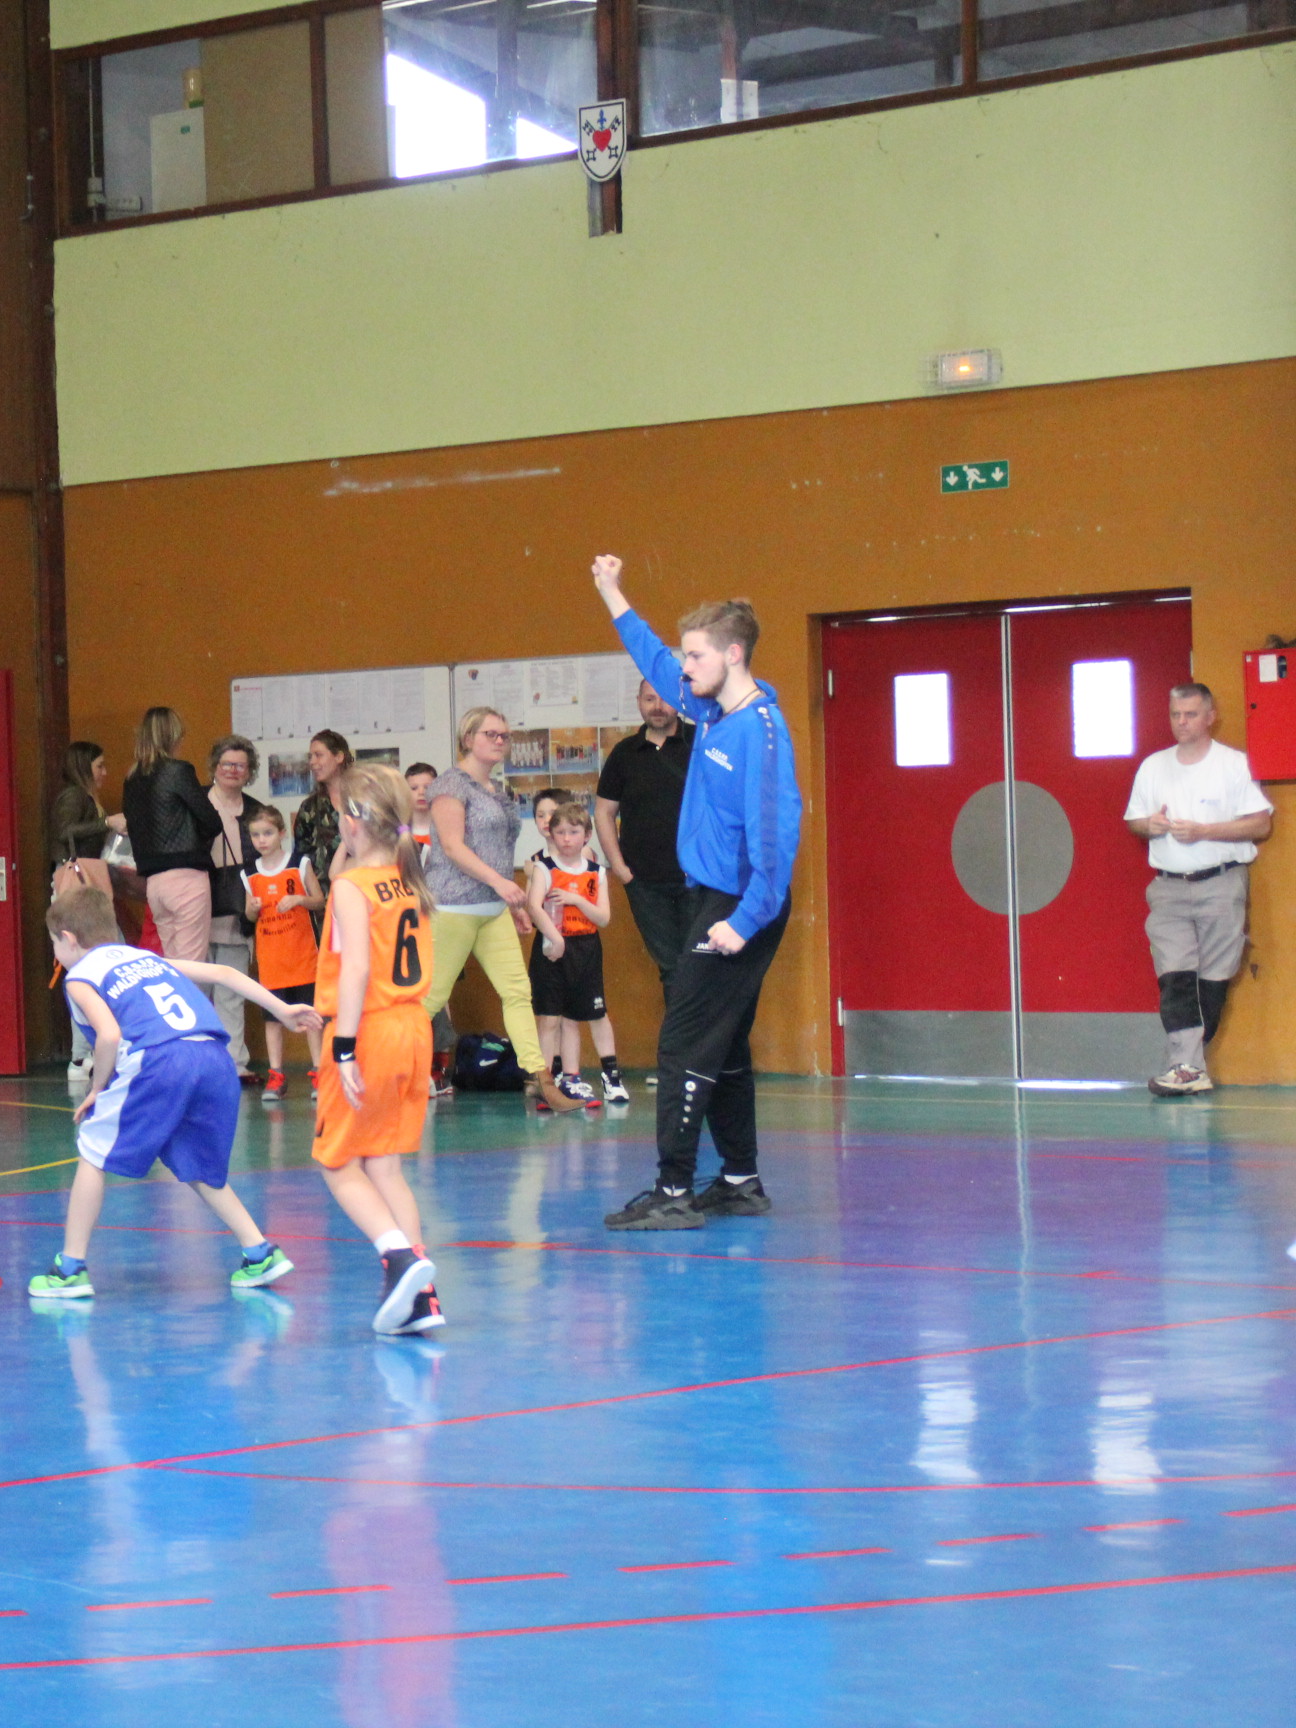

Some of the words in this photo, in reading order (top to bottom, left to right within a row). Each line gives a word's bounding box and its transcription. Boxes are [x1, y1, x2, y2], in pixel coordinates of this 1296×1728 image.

[286, 878, 295, 896] 8
[392, 908, 422, 986] 6
[142, 982, 197, 1031] 5
